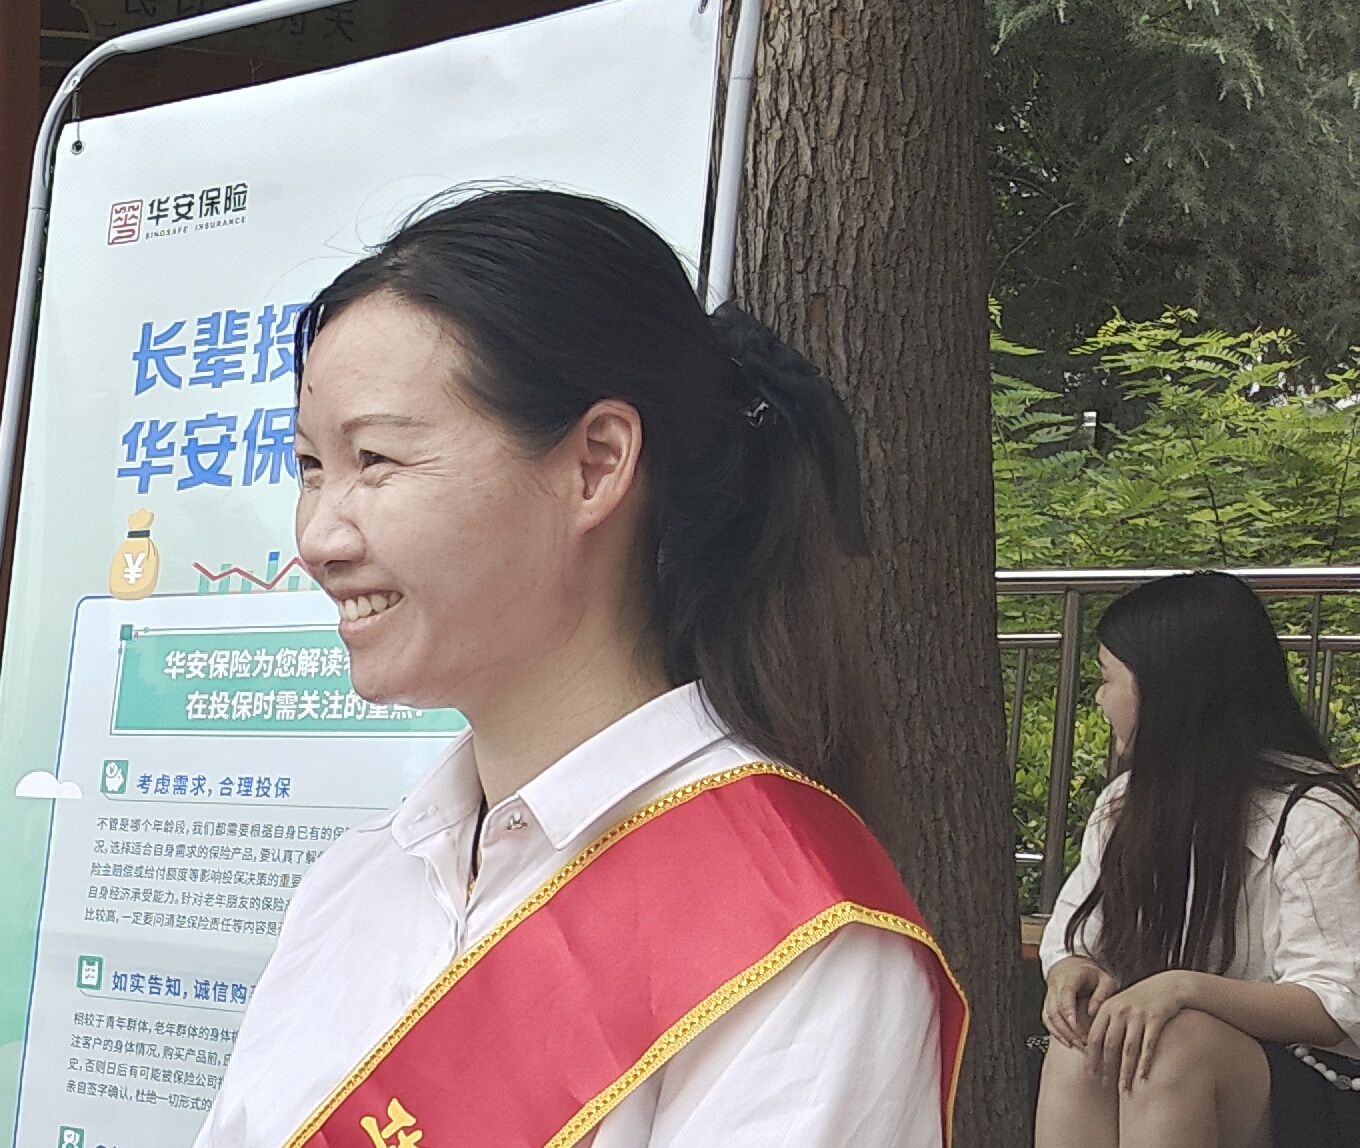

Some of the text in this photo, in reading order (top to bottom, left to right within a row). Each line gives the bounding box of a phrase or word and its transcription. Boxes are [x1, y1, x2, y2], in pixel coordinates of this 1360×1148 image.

[146, 183, 248, 227] 华安保险
[145, 216, 247, 240] SINOSAFE INSURANCE
[117, 407, 298, 495] 华安保
[97, 817, 350, 842] 不管是哪个年龄段,我们都需要根据自身已有的保
[94, 840, 326, 865] 况,选择适合自身需求的保险产品,要认真了解
[111, 971, 257, 1004] 如实告知,诚信购
